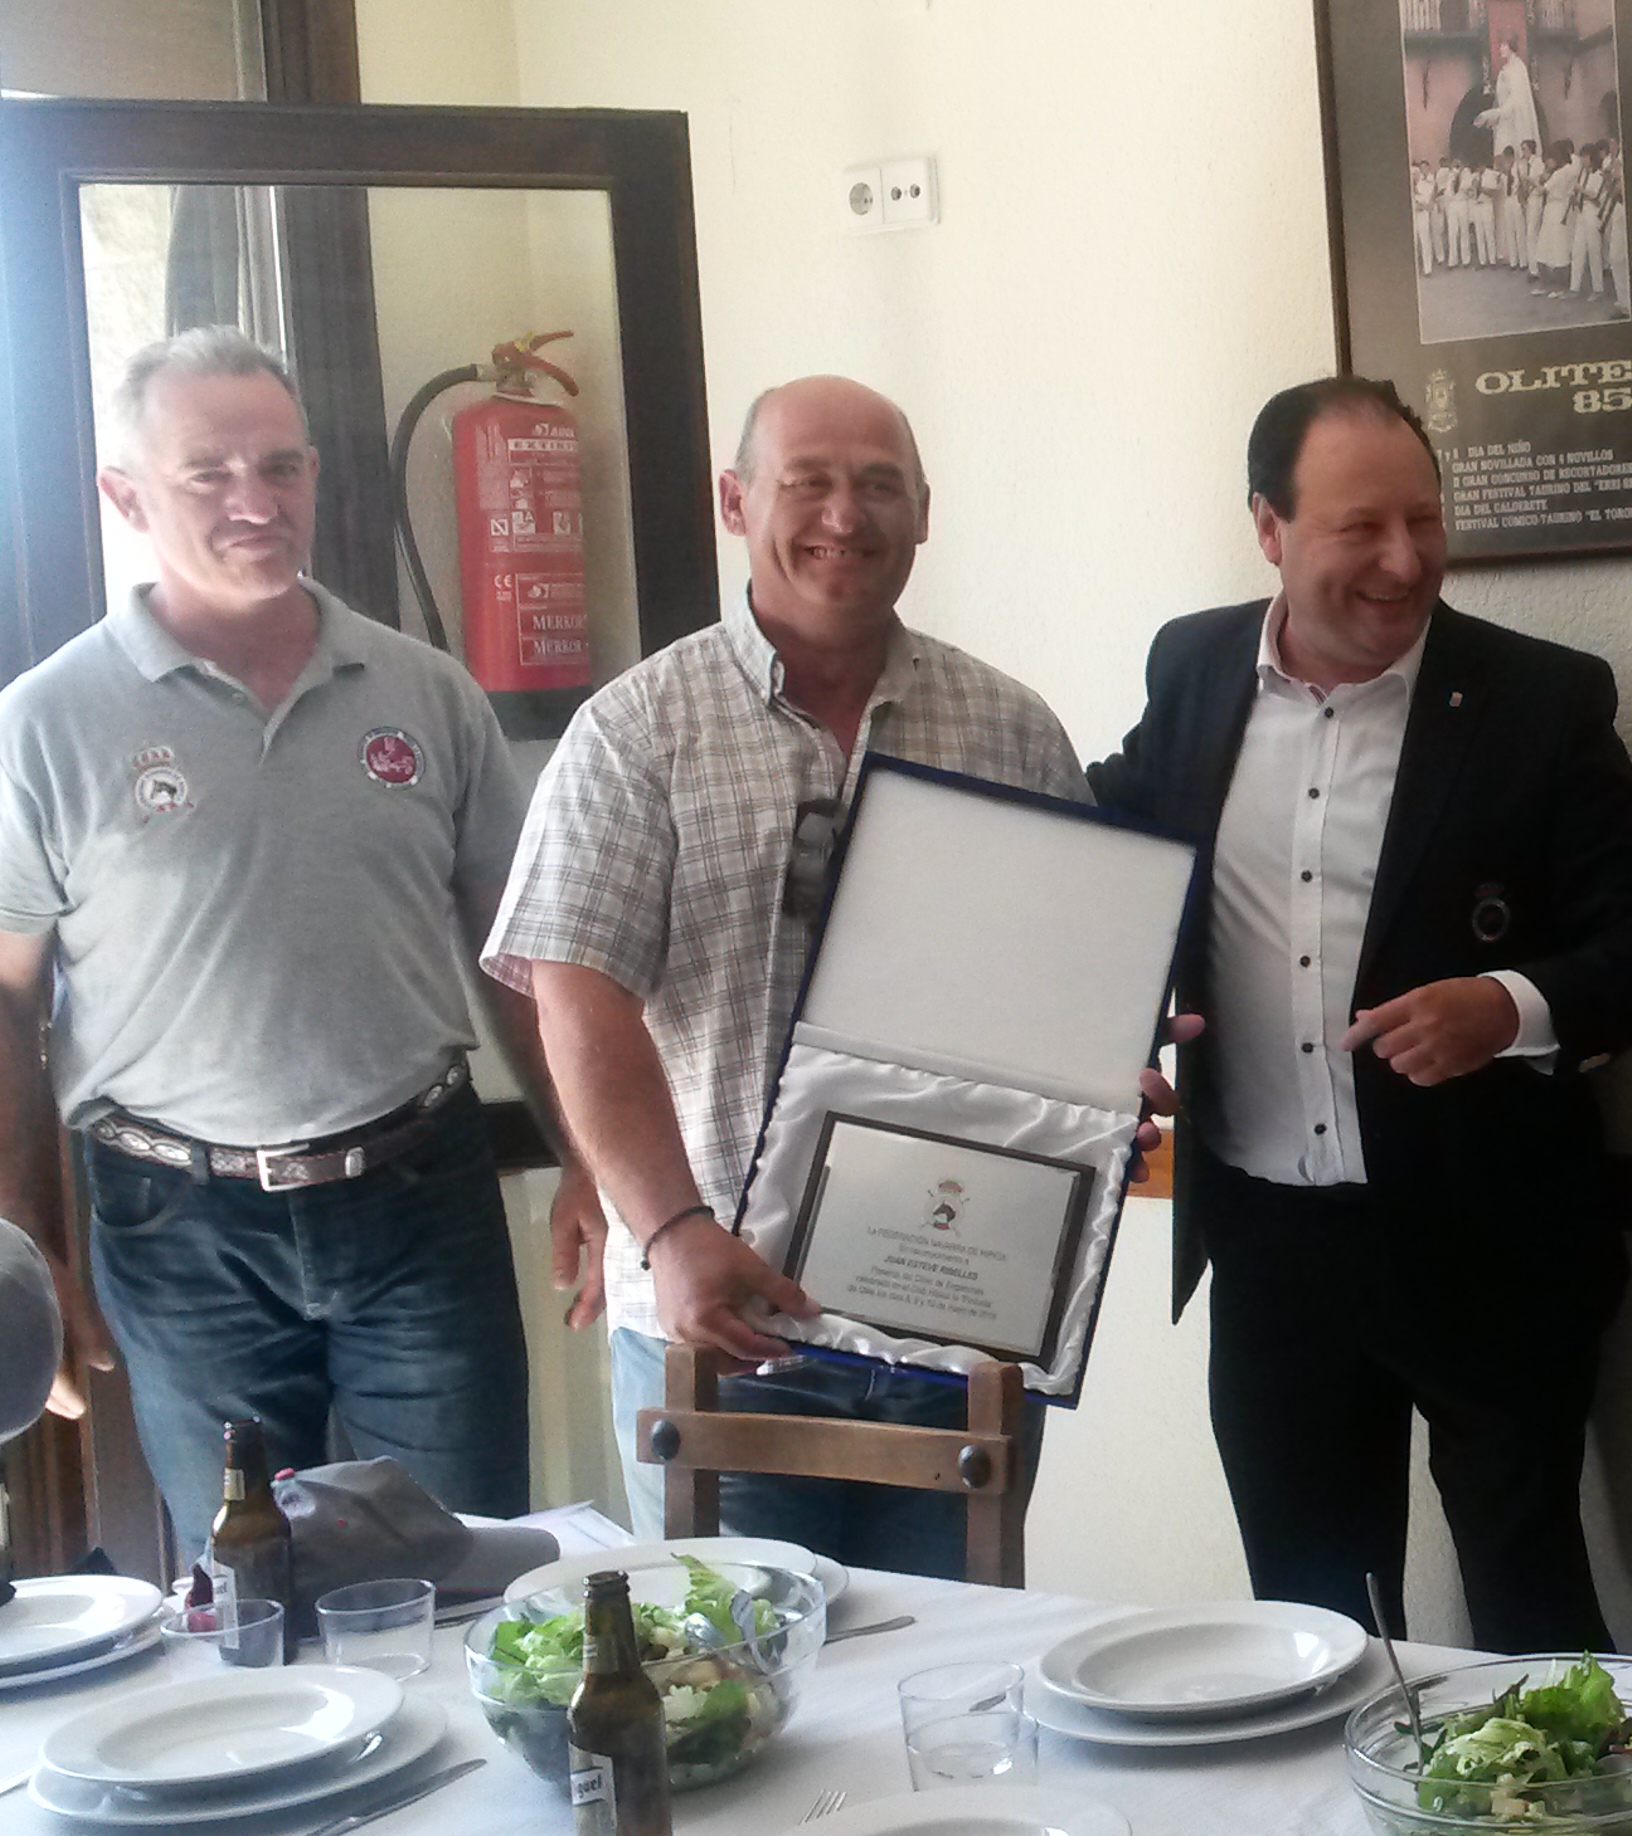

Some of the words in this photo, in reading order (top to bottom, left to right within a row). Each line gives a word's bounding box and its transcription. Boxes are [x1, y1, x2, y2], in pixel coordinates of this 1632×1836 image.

[1475, 360, 1632, 395] OLITE
[1452, 460, 1478, 474] GRAN
[1480, 456, 1533, 471] NOVILLADA
[1536, 453, 1556, 467] CON
[1567, 449, 1613, 464] NOVILLOS
[1468, 446, 1485, 458] DIA
[1487, 444, 1504, 456] DEL
[1462, 474, 1488, 487] GRAN
[1491, 470, 1540, 485] CONCURSO
[1543, 469, 1555, 481] DE
[1559, 462, 1632, 480] RECORTADORES
[1453, 490, 1479, 503] GRAN
[1482, 486, 1526, 500] FESTIVAL
[1528, 481, 1570, 497] TAURINO
[1573, 481, 1591, 493] DEL
[1454, 504, 1471, 516] DIA
[1474, 503, 1492, 515] DEL
[1456, 517, 1499, 531] FESTIVAL
